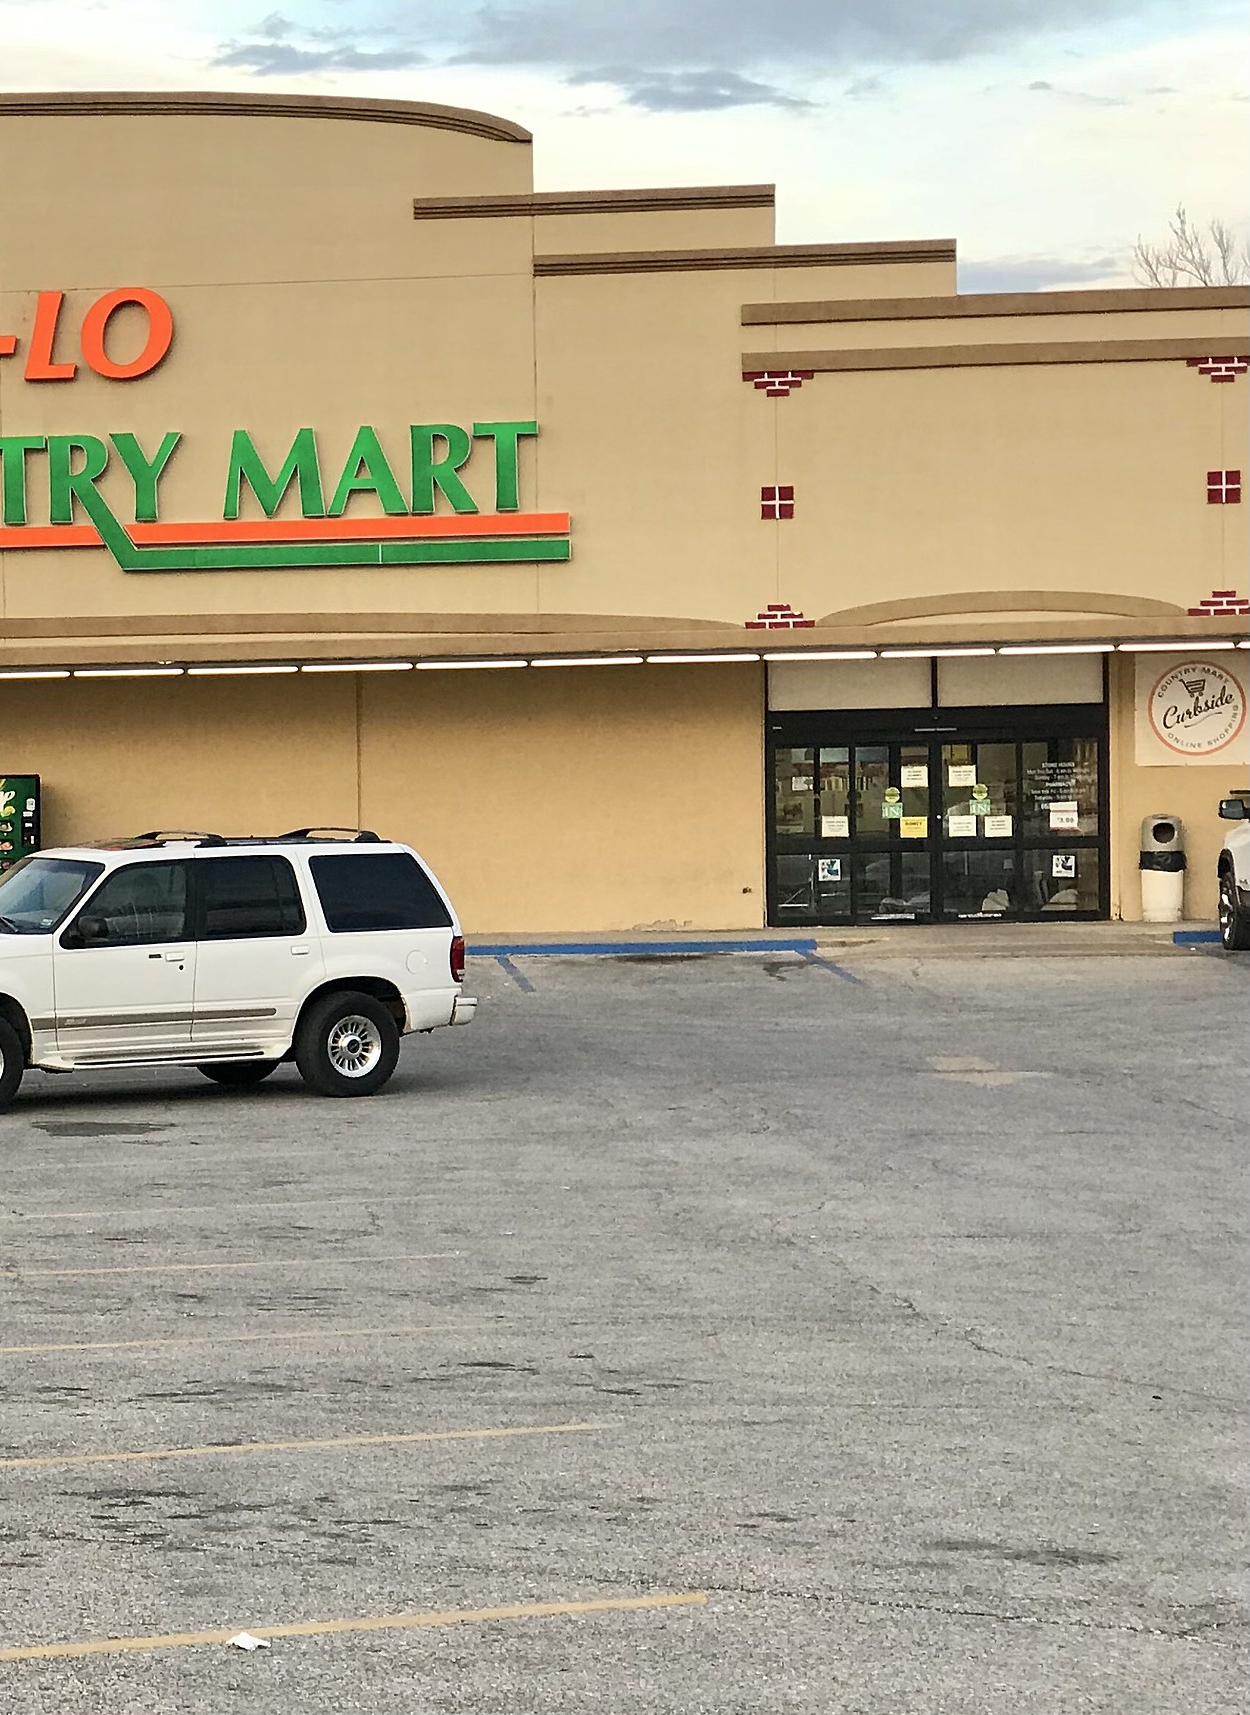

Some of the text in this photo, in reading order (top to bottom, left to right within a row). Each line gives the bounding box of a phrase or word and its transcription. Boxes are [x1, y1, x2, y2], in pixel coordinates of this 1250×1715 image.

[223, 421, 539, 519] MART
[1158, 666, 1230, 698] COUNTRY MART
[1163, 685, 1235, 729] Curbside
[1168, 704, 1239, 748] ONLINE SHOPPING
